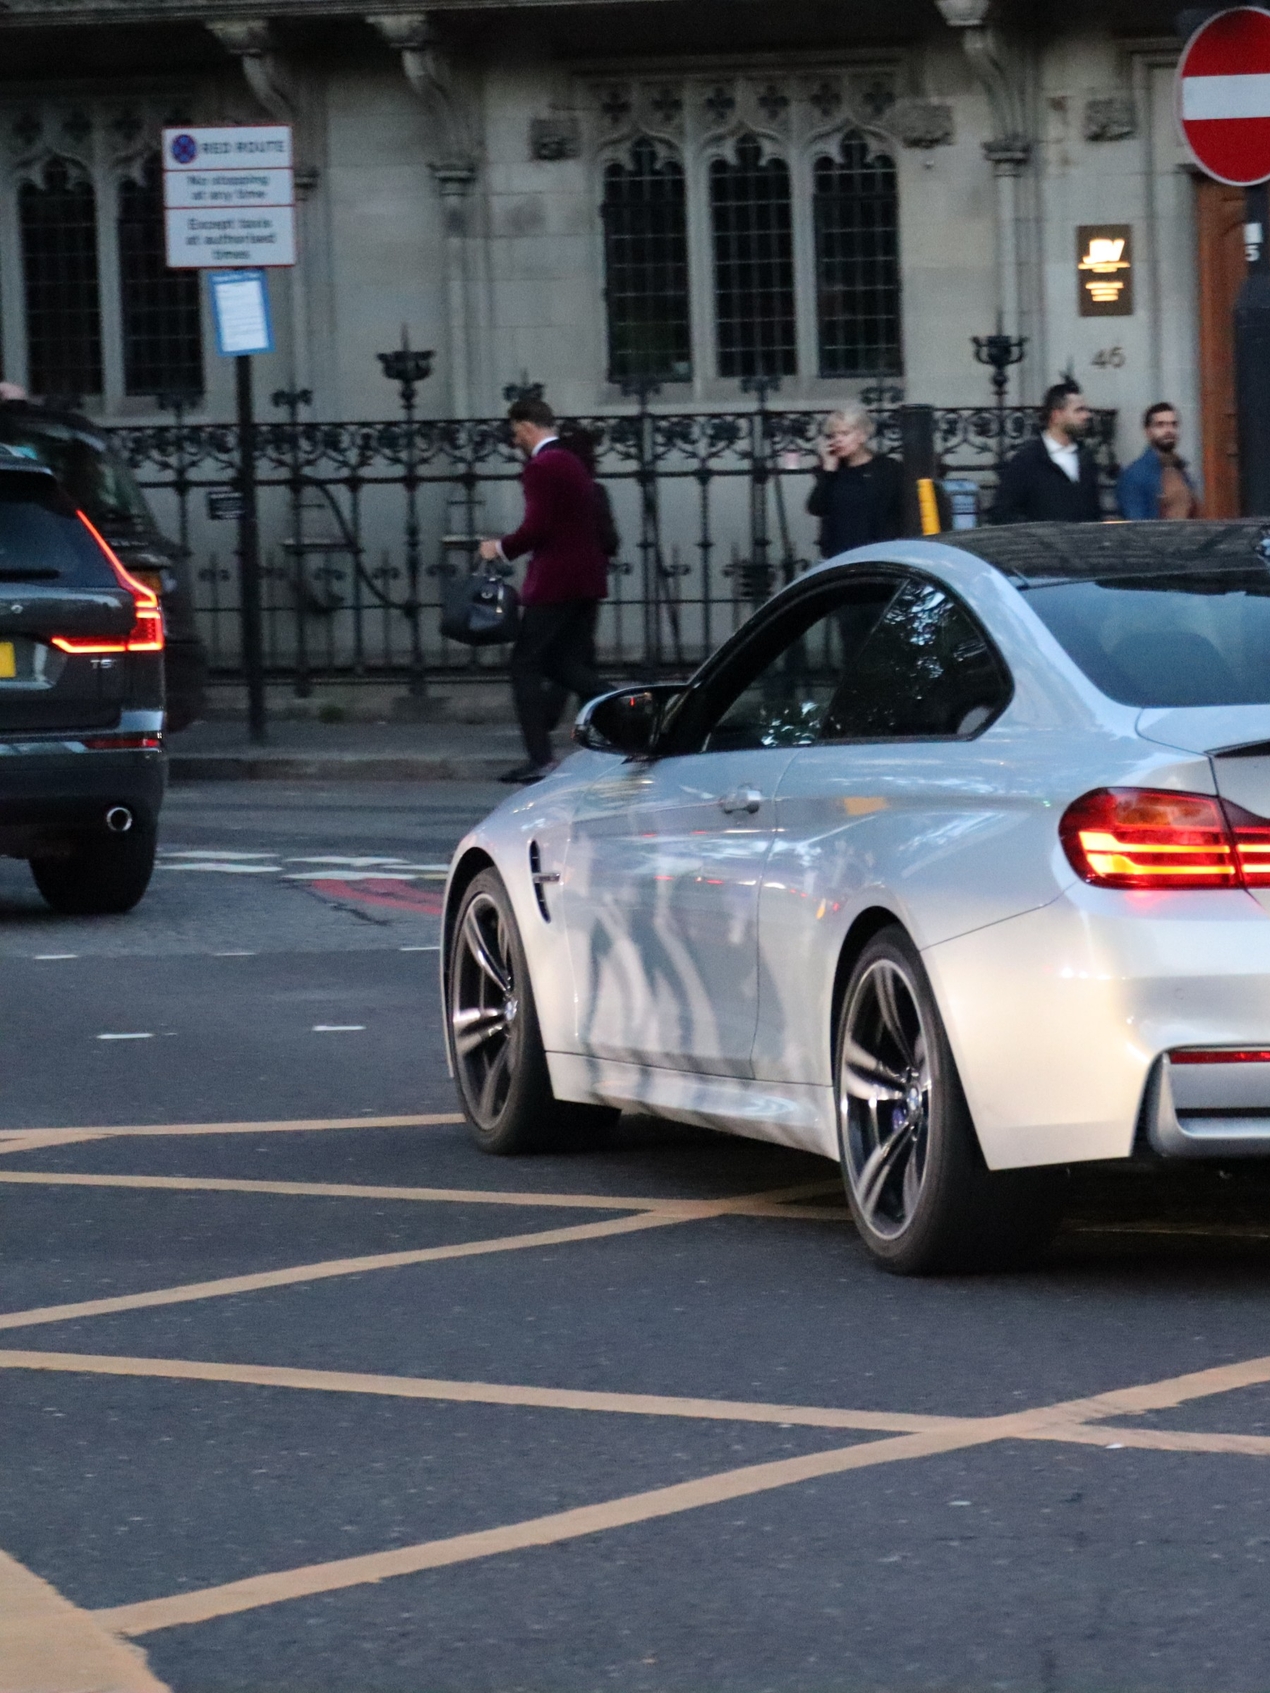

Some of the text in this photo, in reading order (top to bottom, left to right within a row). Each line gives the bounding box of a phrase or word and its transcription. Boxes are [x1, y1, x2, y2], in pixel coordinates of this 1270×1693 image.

[202, 140, 285, 154] RED ROUTE
[212, 175, 269, 187] stopping
[187, 218, 234, 231] Except
